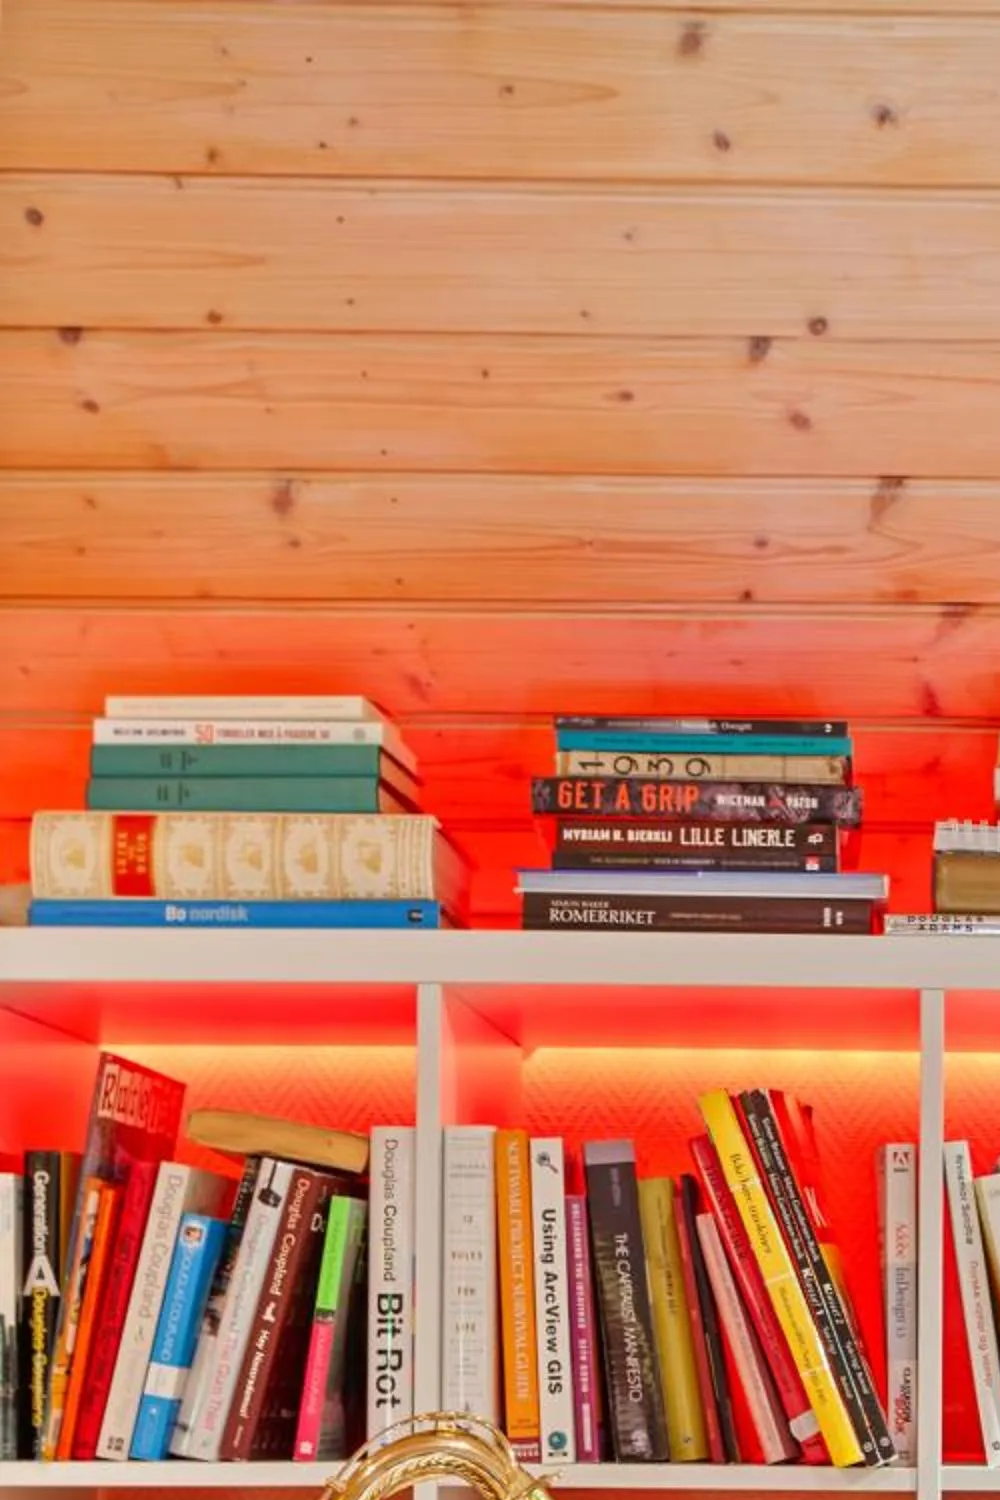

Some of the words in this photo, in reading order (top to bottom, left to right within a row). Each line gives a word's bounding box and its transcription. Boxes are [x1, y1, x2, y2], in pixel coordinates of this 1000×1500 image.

[558, 781, 604, 809] GET
[616, 781, 630, 809] A
[641, 783, 699, 814] GRIP
[680, 828, 724, 845] LILLE
[732, 829, 796, 847] LINERLE
[165, 904, 187, 921] Bo
[189, 904, 248, 921] nordisk
[550, 909, 656, 925] ROMERRIKET
[381, 1139, 398, 1200] Douglas
[32, 1171, 51, 1256] Generation
[155, 1174, 185, 1240] Douglas
[287, 1178, 312, 1230] Douglas
[268, 1233, 297, 1296] Coupland
[381, 1204, 398, 1281] Coupland
[540, 1208, 558, 1265] Using
[614, 1232, 629, 1257] THE
[137, 1243, 170, 1319] Coupland
[30, 1288, 49, 1350] Douglas
[376, 1292, 403, 1341] Bit
[543, 1271, 560, 1353] ArcView
[375, 1349, 402, 1408] Rot
[547, 1359, 563, 1395] GIS
